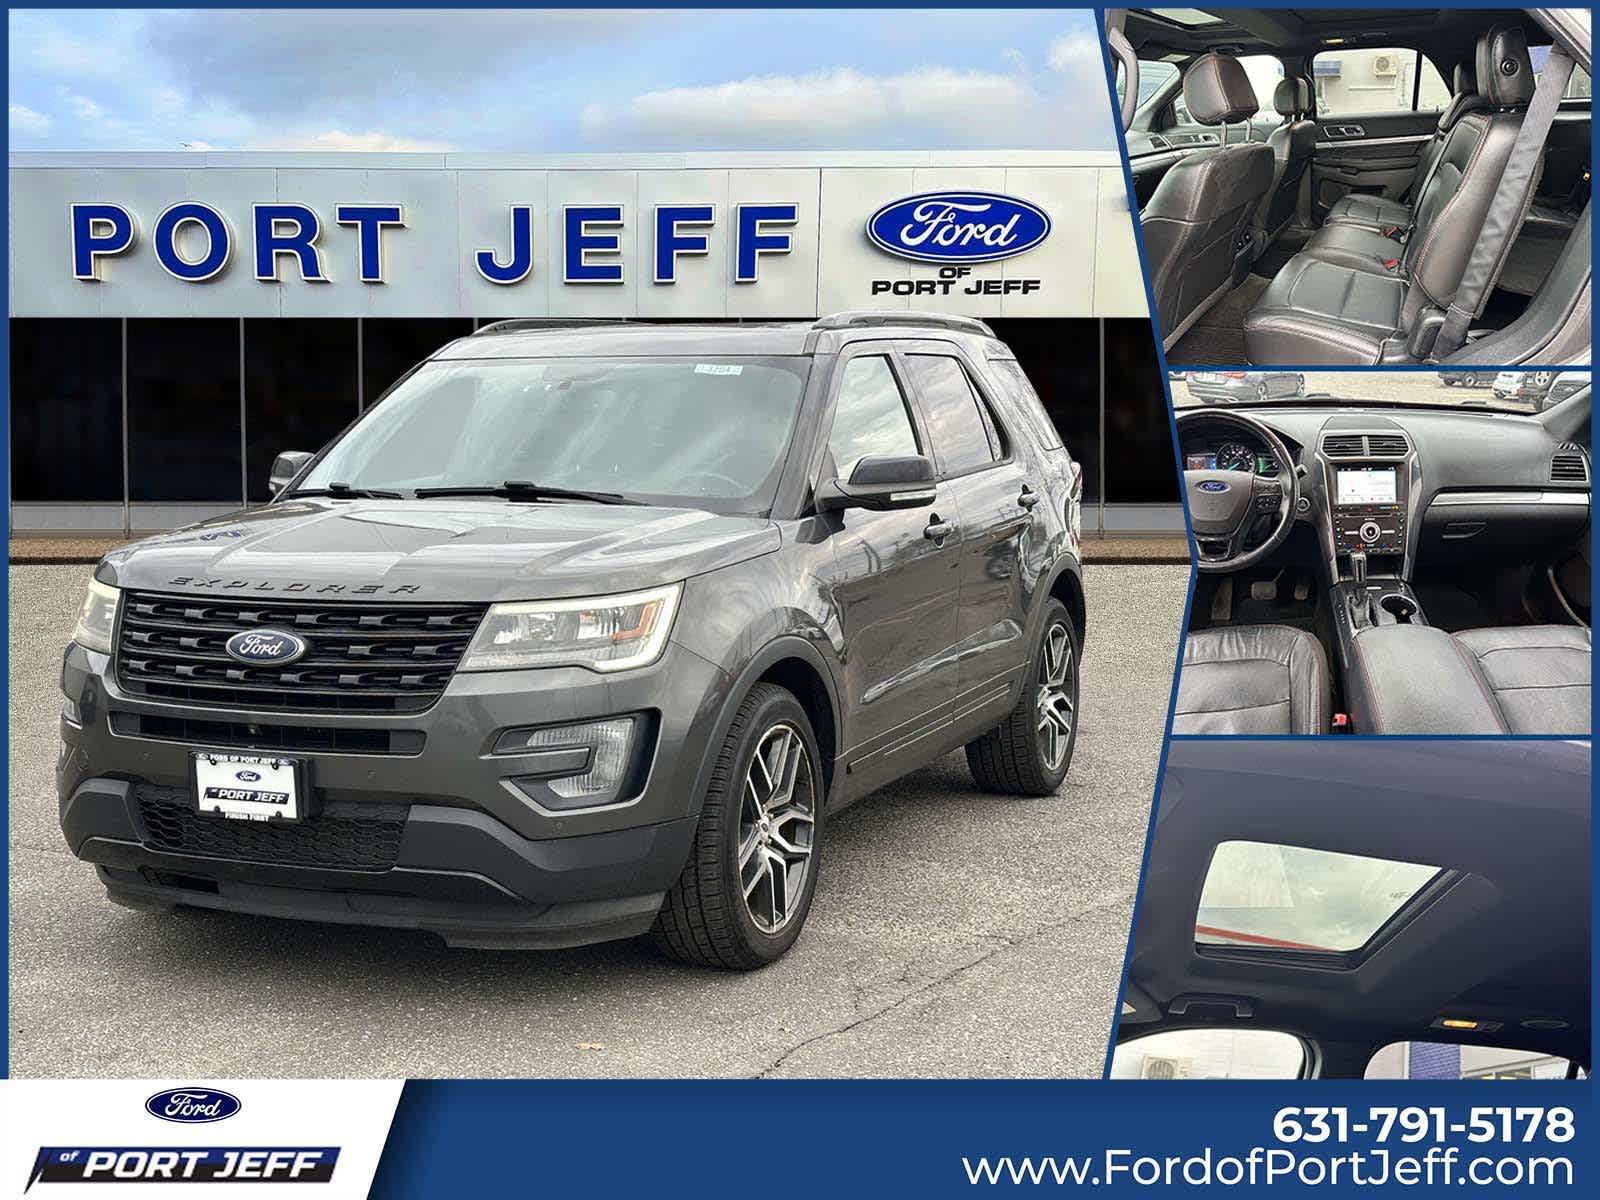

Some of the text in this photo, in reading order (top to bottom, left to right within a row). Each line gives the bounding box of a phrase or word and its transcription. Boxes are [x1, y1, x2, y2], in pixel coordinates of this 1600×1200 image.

[900, 201, 1021, 246] Ford
[70, 202, 799, 284] PORT JEFF
[939, 267, 971, 279] OF
[871, 280, 1041, 295] PORT JEFF
[168, 576, 421, 594] EXPLORER
[239, 635, 281, 656] Ford
[218, 789, 254, 801] PORT
[254, 791, 286, 803] JEFF
